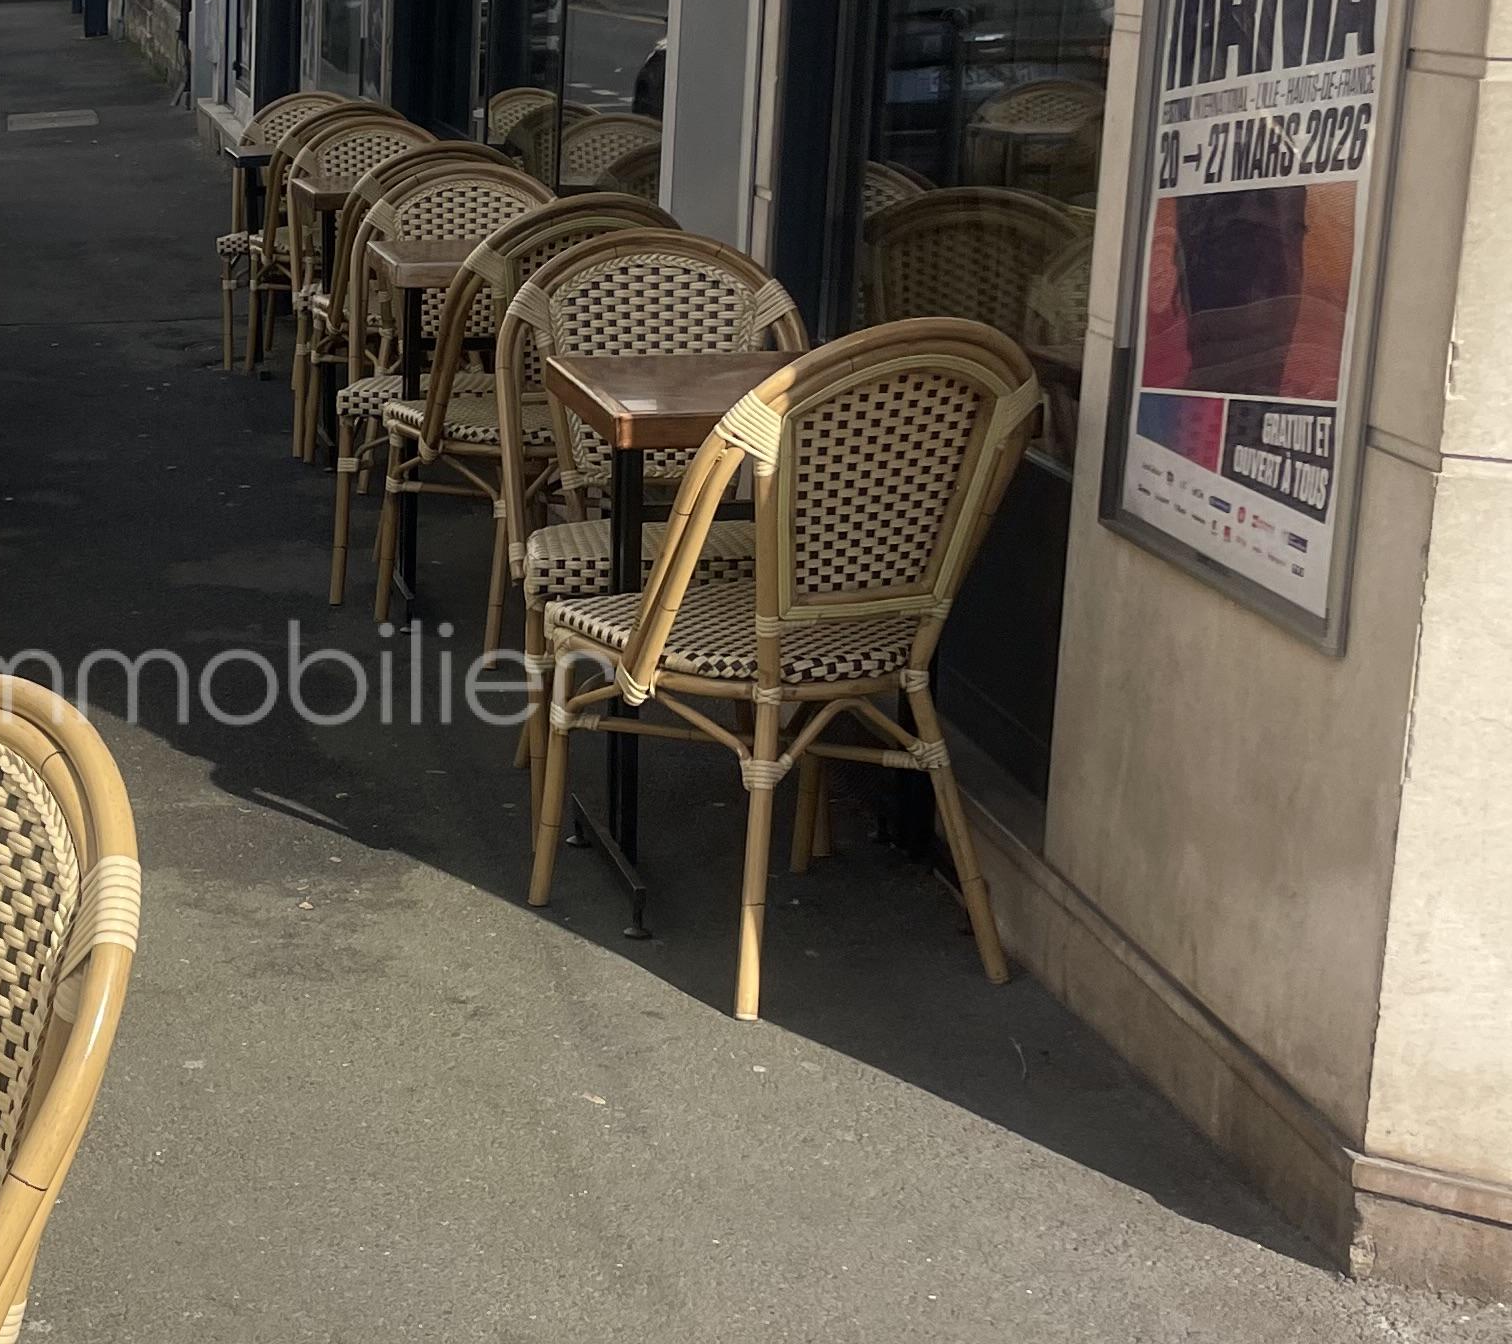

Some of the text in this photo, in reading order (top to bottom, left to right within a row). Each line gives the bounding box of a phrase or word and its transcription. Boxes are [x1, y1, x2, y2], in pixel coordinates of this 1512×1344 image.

[1158, 102, 1372, 190] 20 27 MARS 2026
[1262, 412, 1332, 458] GRATUIT ET
[1233, 444, 1283, 489] OUVERT
[1292, 460, 1329, 510] TOUS
